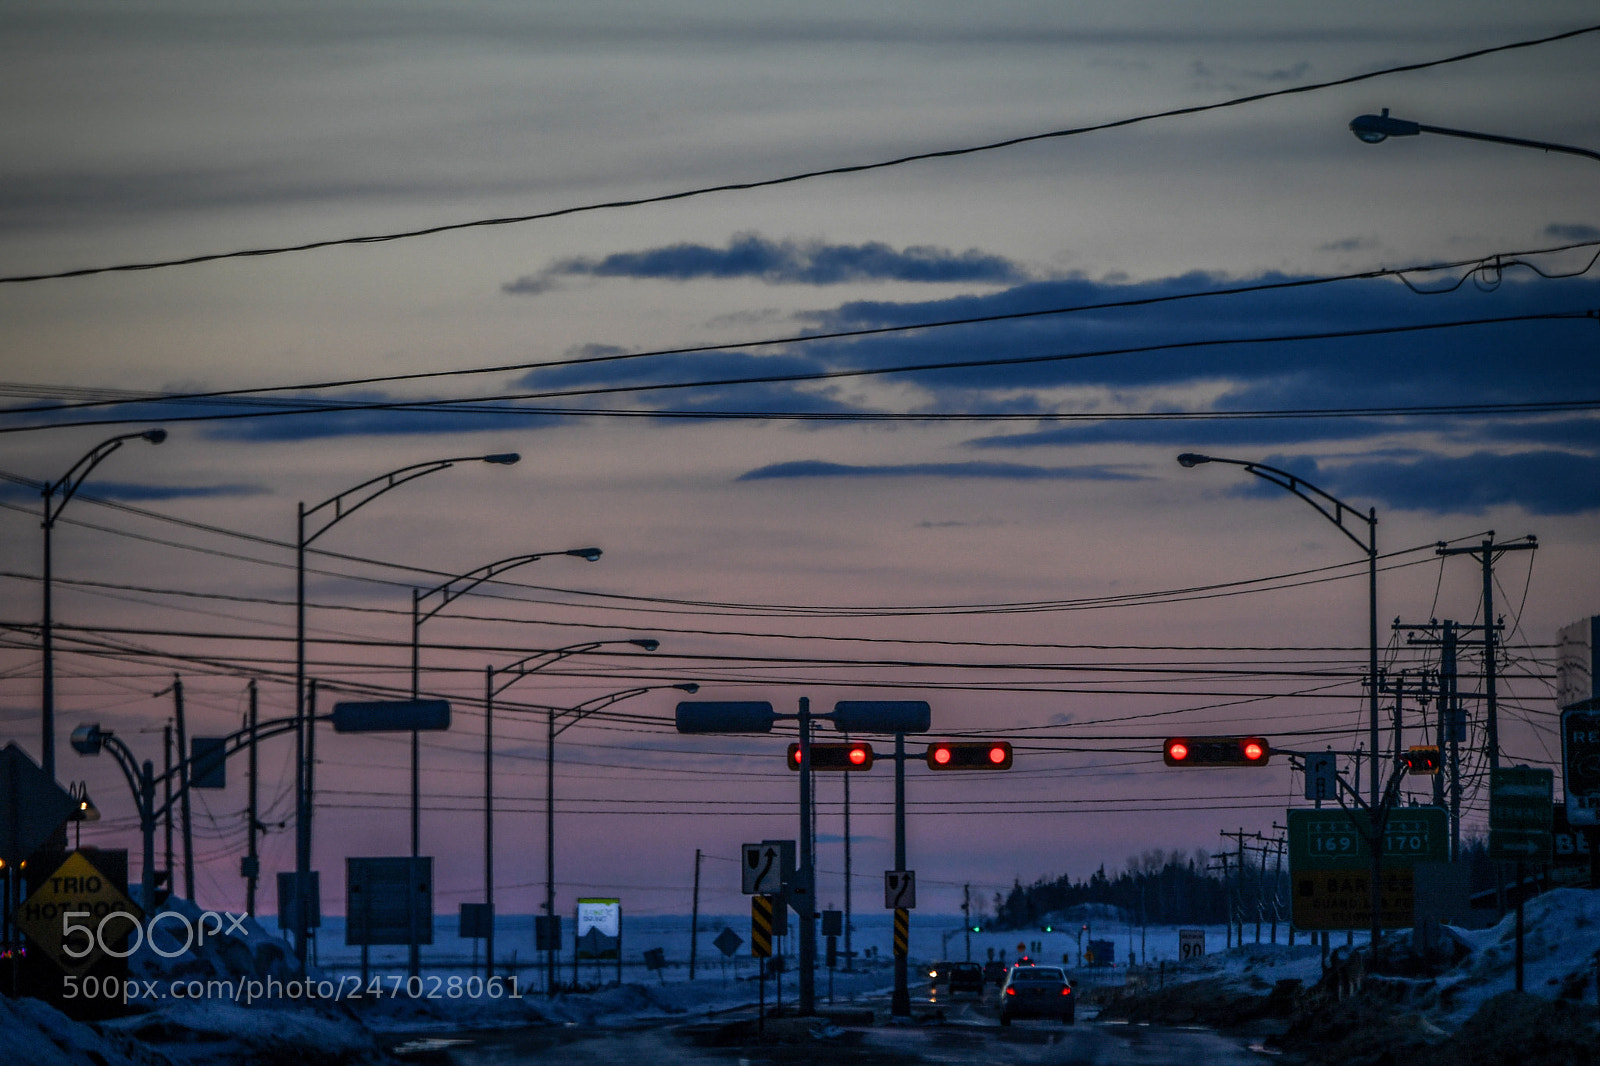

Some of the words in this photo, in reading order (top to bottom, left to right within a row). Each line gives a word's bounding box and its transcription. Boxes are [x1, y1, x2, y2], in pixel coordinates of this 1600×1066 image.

[1317, 837, 1351, 851] 169
[1387, 836, 1421, 850] 170
[51, 876, 101, 894] TRIO
[26, 903, 71, 921] HOT
[1182, 943, 1202, 958] 90
